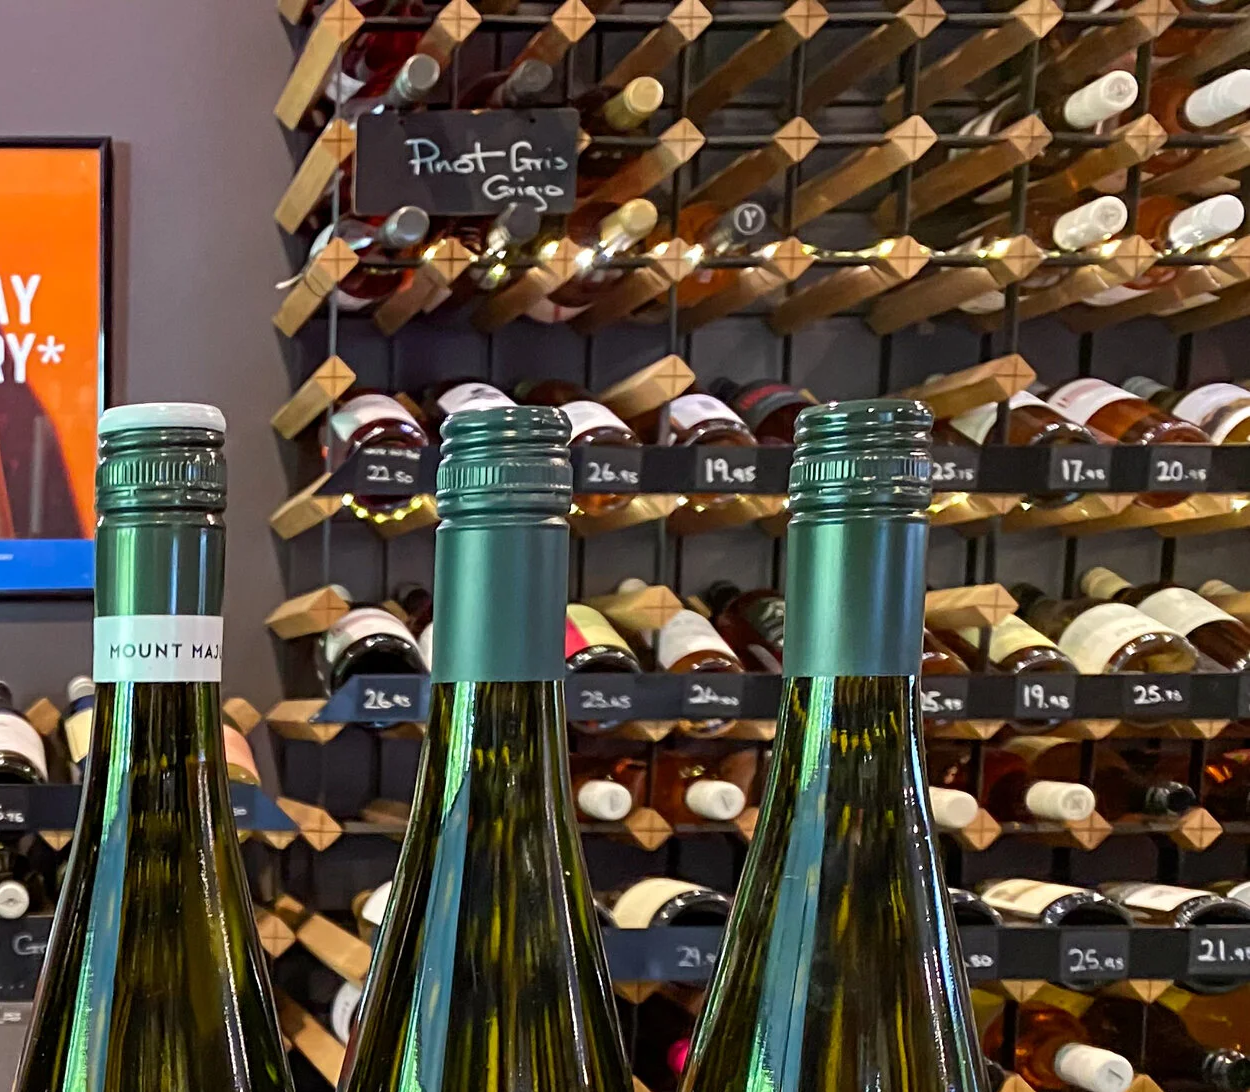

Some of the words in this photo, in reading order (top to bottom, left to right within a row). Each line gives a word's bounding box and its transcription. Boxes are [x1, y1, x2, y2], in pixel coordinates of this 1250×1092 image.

[404, 138, 505, 176] Pinot
[509, 141, 569, 173] Gris
[110, 643, 183, 660] MOUNT
[192, 643, 223, 660] MAJ
